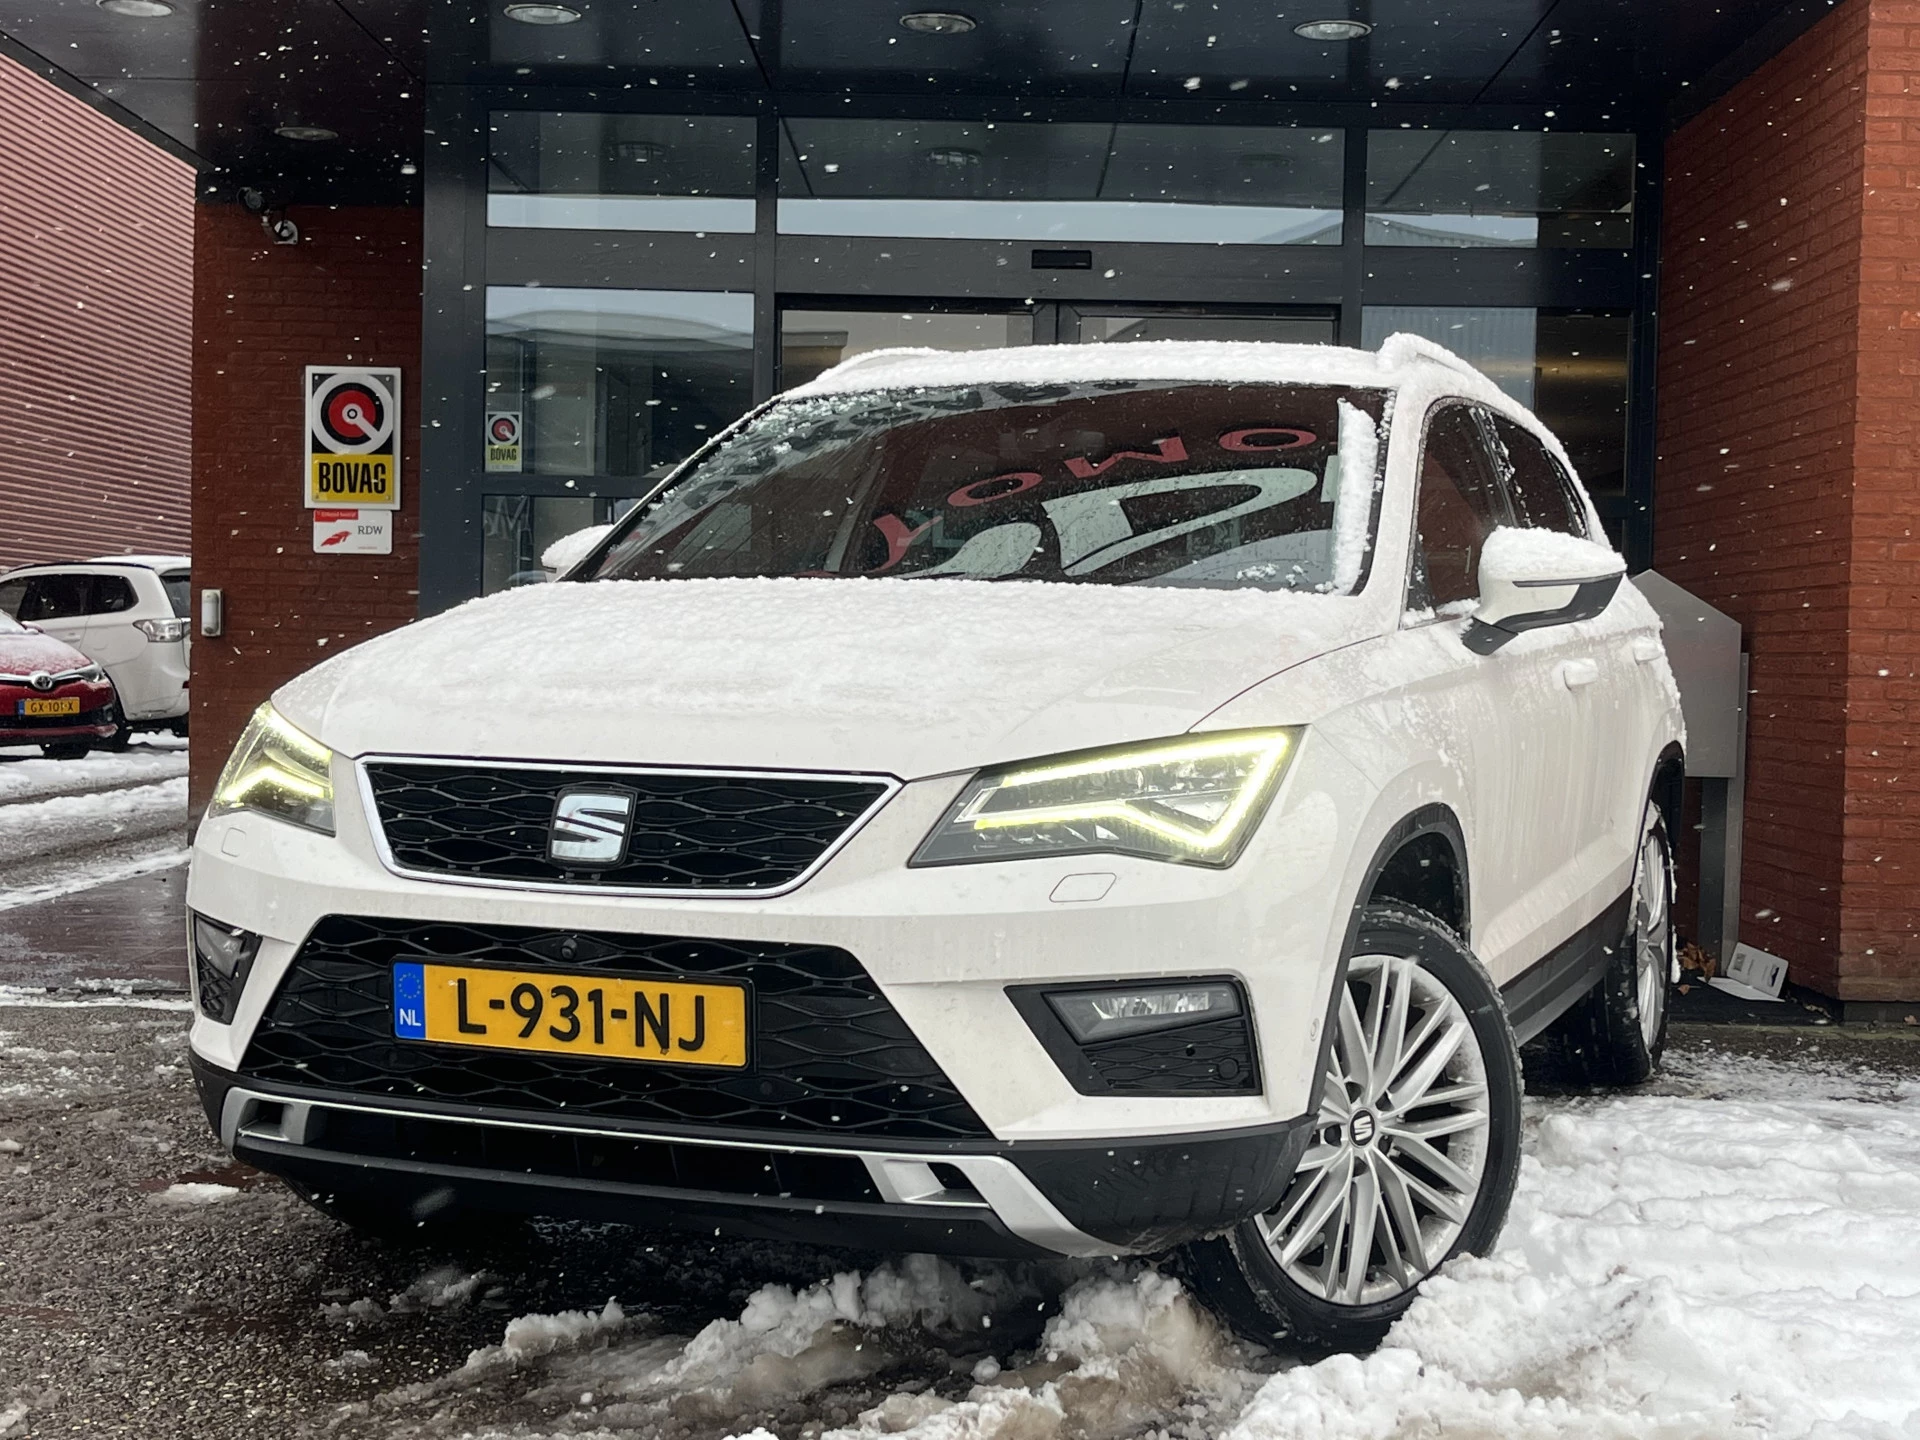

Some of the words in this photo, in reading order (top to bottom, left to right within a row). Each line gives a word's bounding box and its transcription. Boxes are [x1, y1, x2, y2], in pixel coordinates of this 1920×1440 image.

[490, 448, 517, 461] BOVAG
[318, 462, 386, 494] BOVAG
[357, 525, 383, 535] RDW
[399, 1007, 422, 1027] NL
[456, 978, 706, 1052] L-931-NJ
